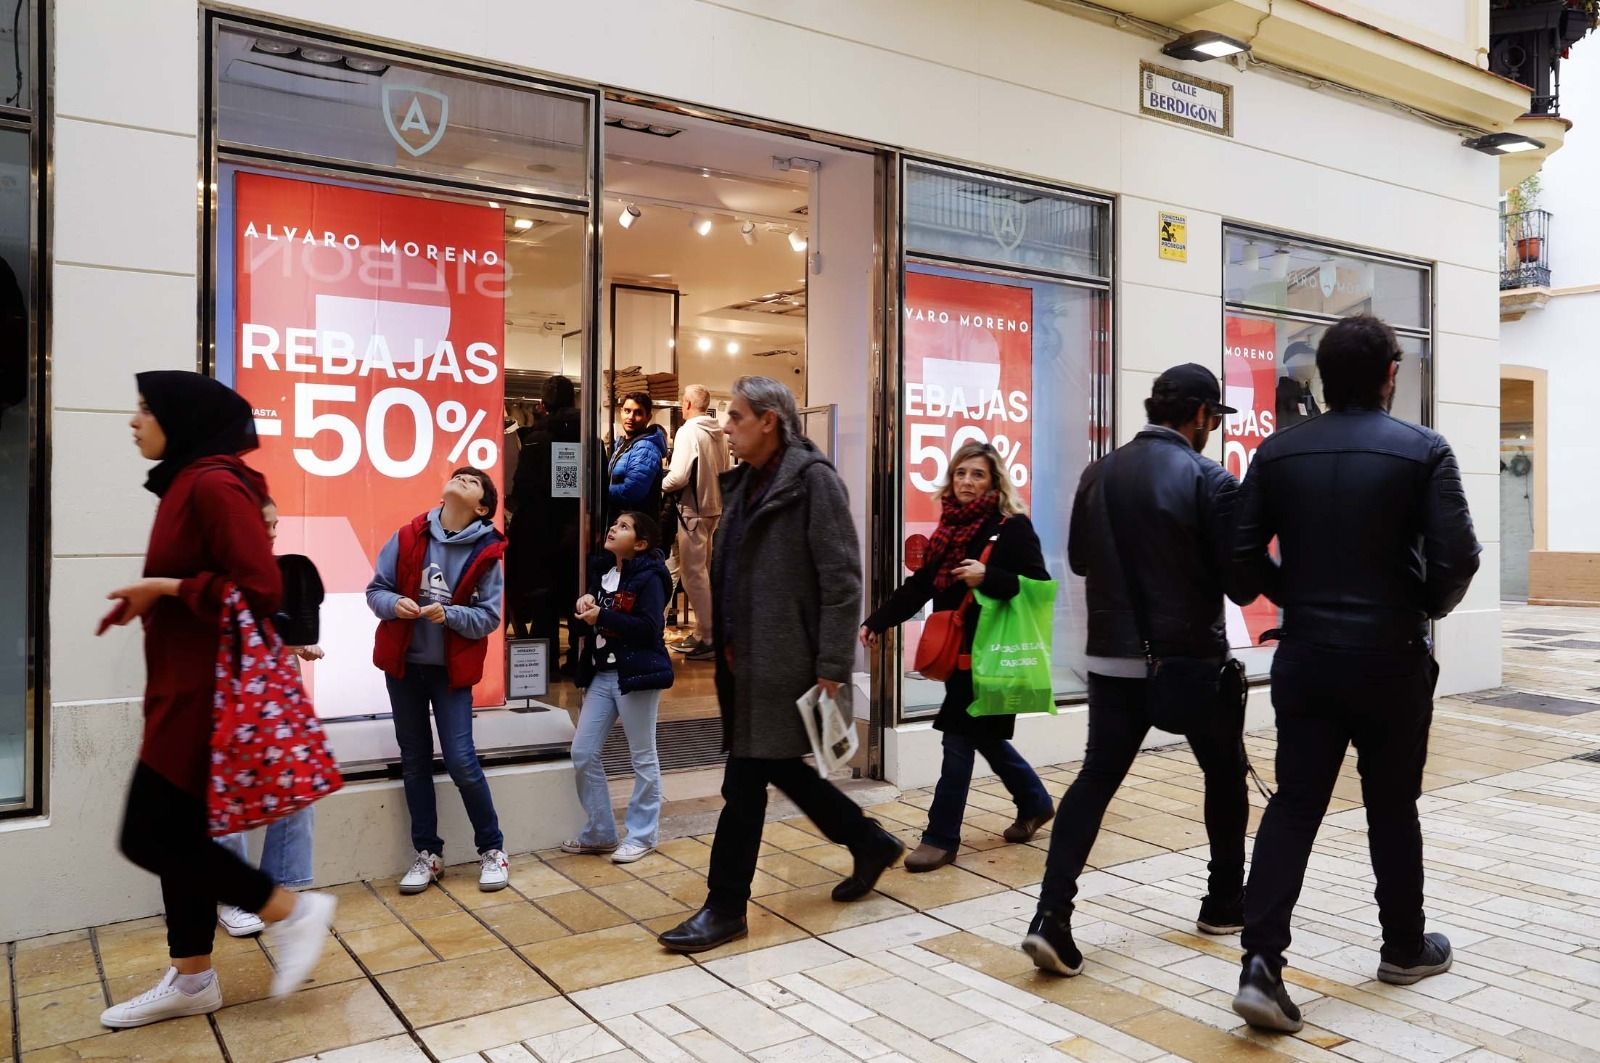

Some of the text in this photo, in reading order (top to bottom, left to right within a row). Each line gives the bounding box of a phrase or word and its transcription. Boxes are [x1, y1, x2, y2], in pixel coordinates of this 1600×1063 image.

[1171, 81, 1197, 97] CALLE
[244, 221, 499, 266] ALVARO MORENO
[960, 315, 1029, 333] MORENO
[241, 322, 499, 385] REBAJAS
[1225, 346, 1274, 361] MORENO
[251, 407, 278, 417] ASTA
